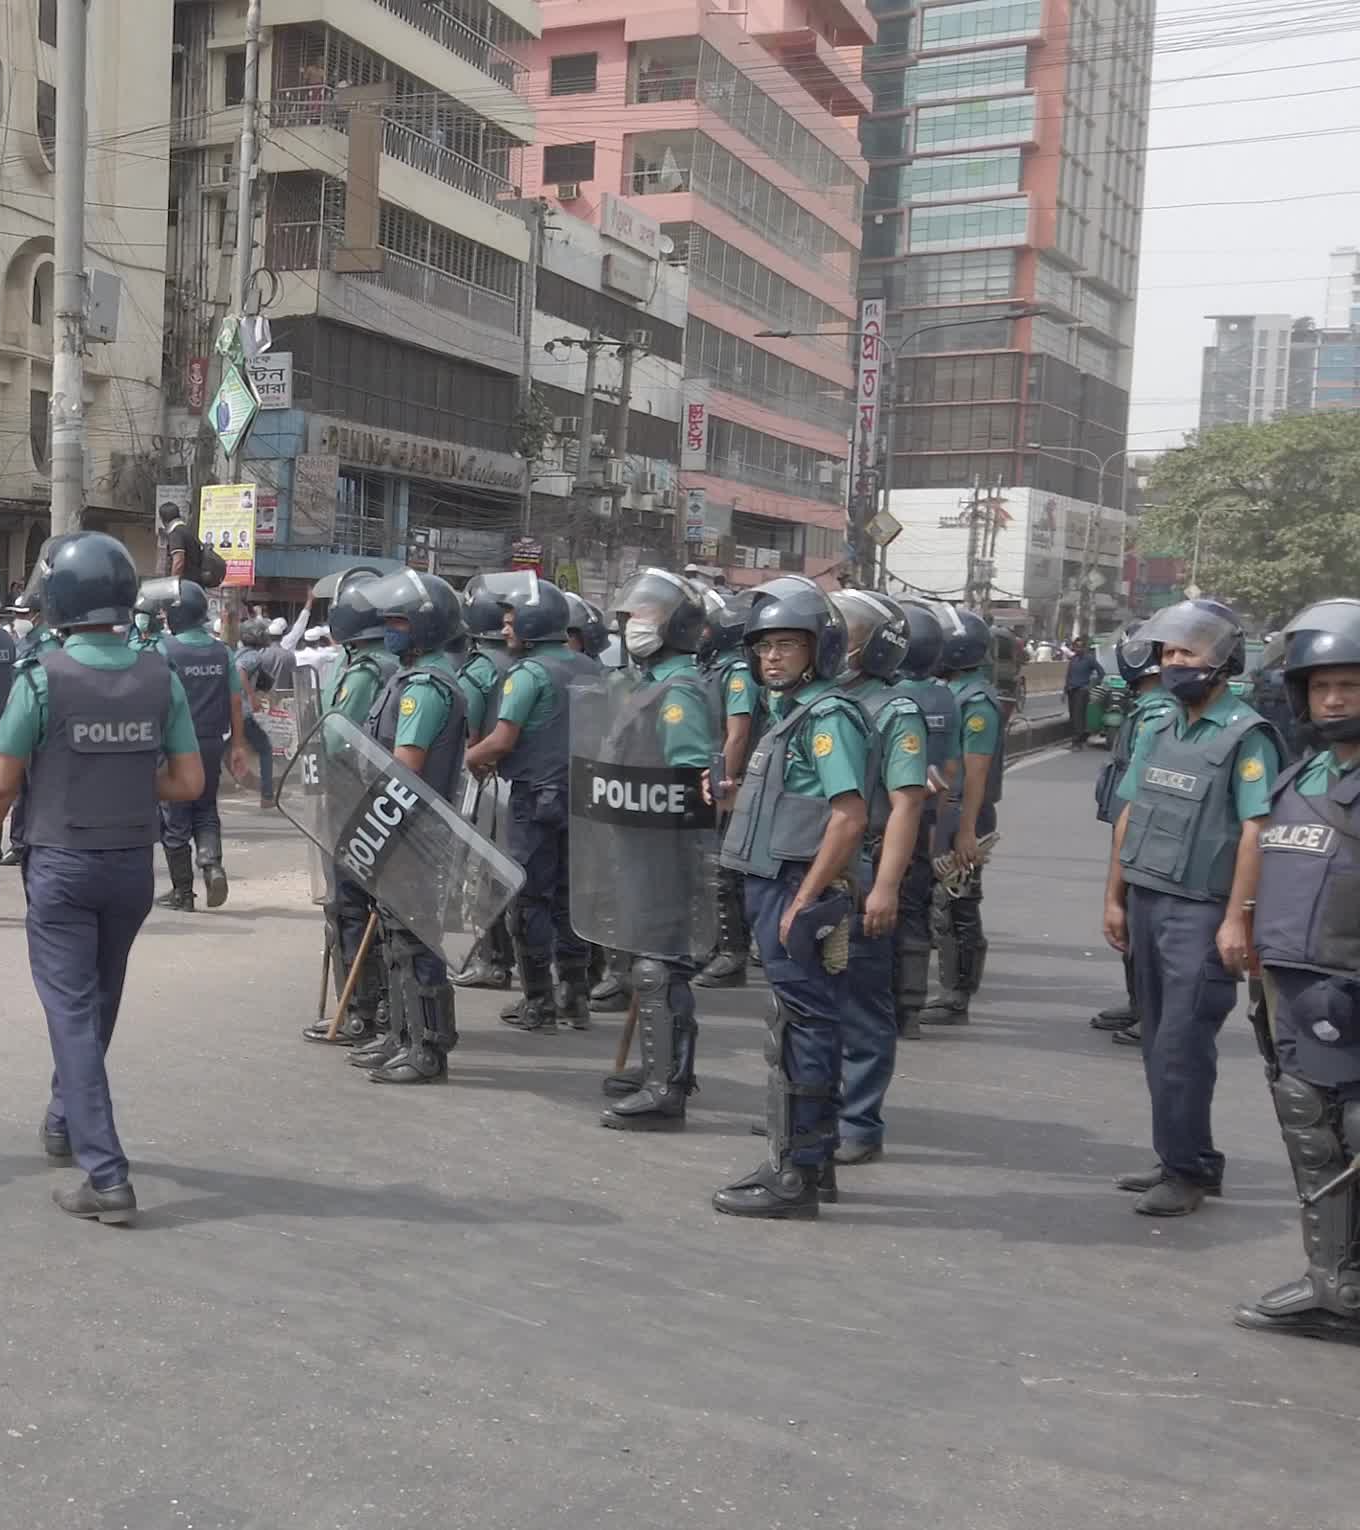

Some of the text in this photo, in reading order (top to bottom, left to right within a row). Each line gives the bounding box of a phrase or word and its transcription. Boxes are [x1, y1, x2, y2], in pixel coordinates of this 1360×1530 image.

[185, 664, 223, 677] POLICE
[73, 722, 154, 744] POLICE
[592, 776, 686, 814] POLICE
[343, 777, 420, 881] POLICE
[1261, 824, 1324, 848] POLICE
